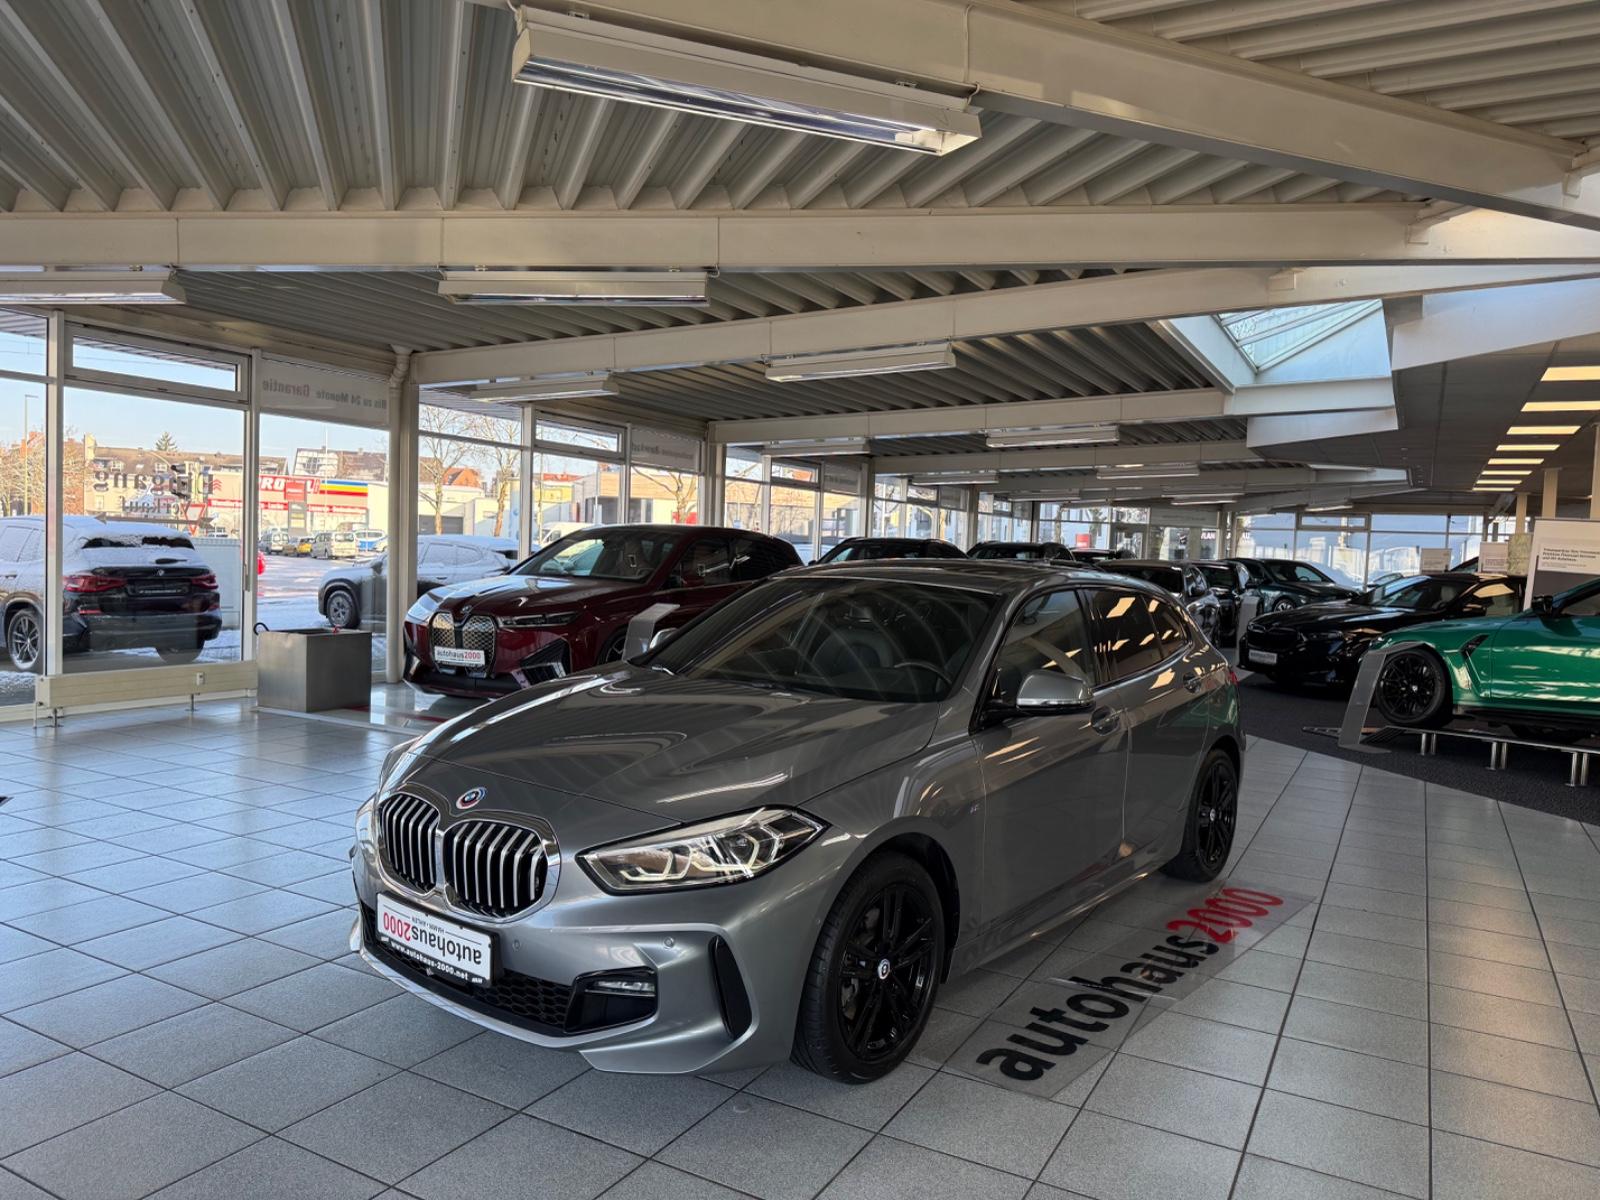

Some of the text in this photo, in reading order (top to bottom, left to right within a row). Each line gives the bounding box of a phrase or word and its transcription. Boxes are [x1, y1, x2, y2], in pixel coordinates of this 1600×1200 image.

[436, 648, 482, 661] autohaus2000
[382, 911, 482, 965] autohaus2000
[975, 887, 1285, 1081] autohaus2000
